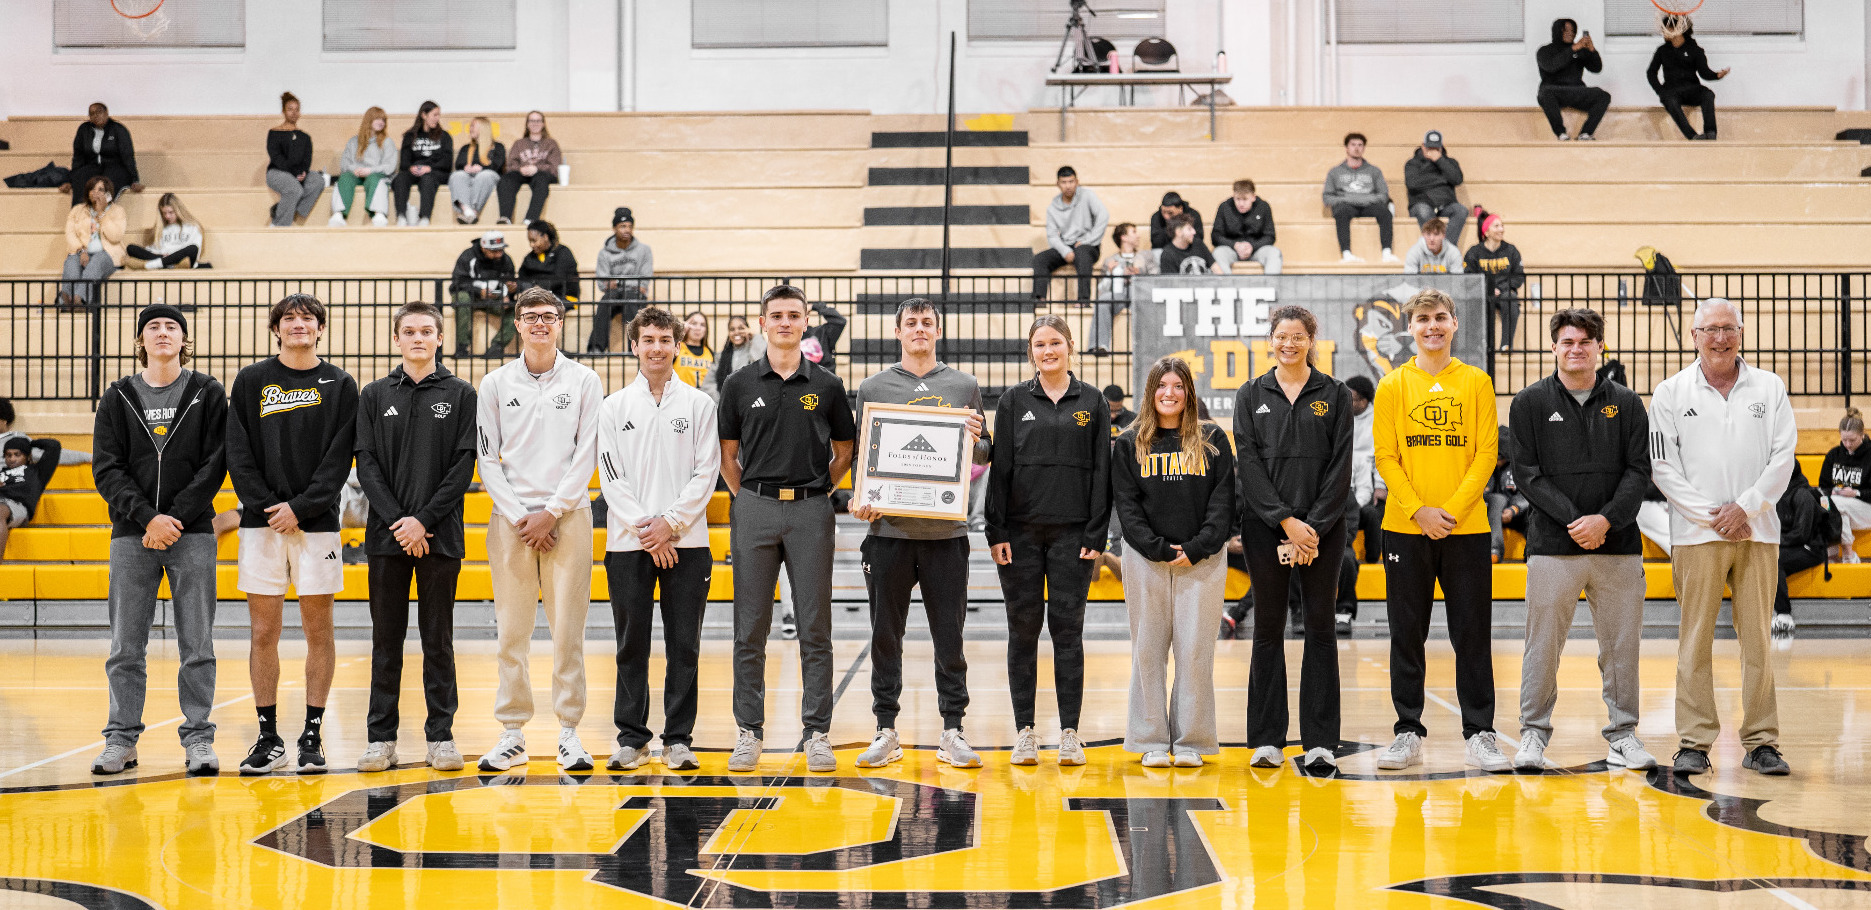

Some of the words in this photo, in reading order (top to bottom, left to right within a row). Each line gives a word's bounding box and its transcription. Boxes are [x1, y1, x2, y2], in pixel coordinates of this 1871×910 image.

[1152, 288, 1276, 337] THE
[262, 386, 319, 405] Braves
[1424, 405, 1448, 425] OU
[1406, 435, 1441, 447] BRAVES
[1445, 435, 1467, 447] GOLF
